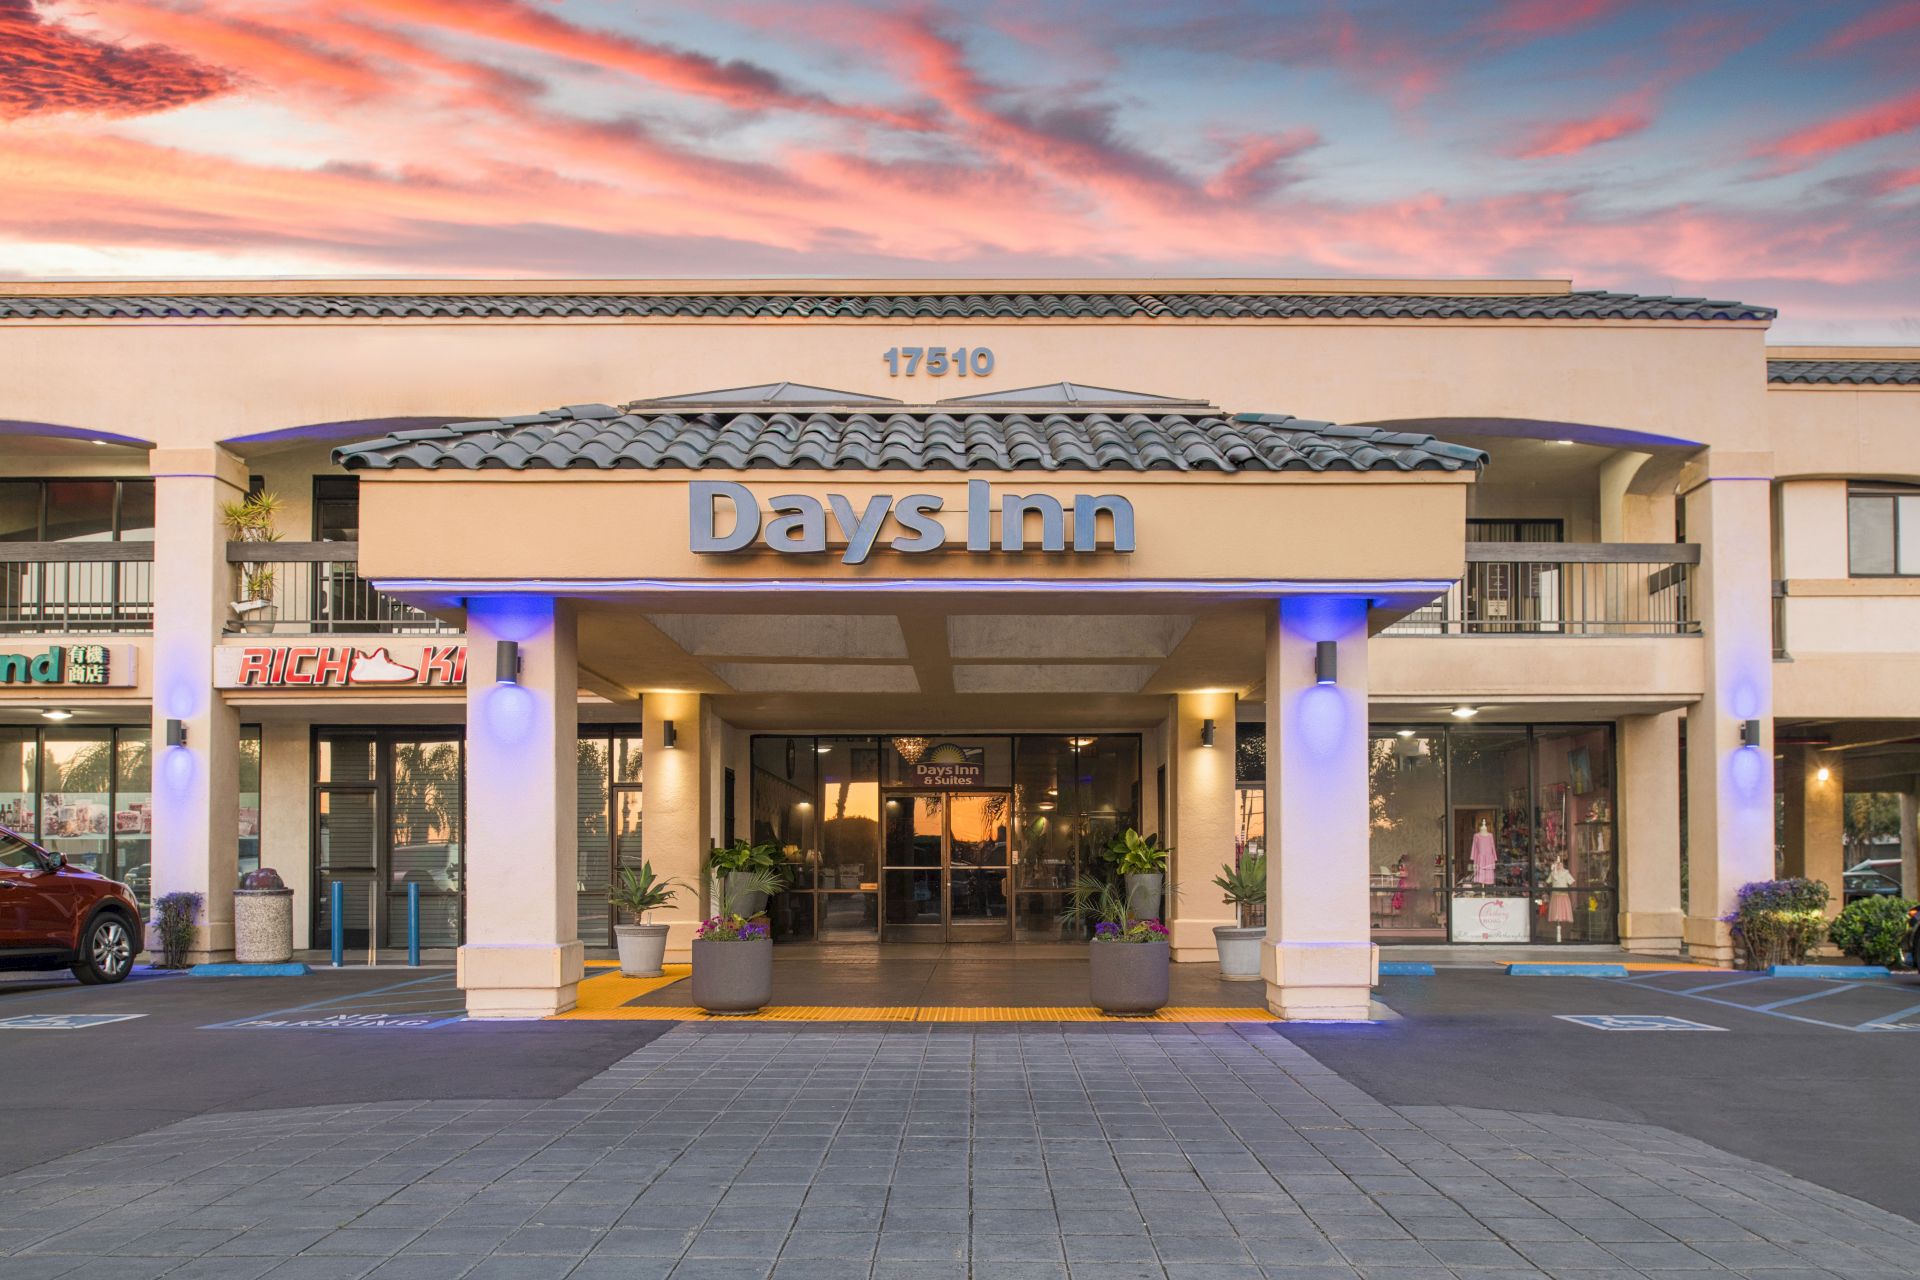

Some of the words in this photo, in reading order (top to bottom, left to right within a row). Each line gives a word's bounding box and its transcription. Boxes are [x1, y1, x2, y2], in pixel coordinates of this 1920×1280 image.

[883, 347, 994, 376] 17510
[689, 479, 946, 565] Days
[967, 479, 1136, 553] Inn
[68, 664, 106, 683] 商店
[236, 647, 352, 685] RICH
[916, 764, 953, 776] Days
[954, 765, 979, 775] Inn
[924, 776, 933, 785] &
[934, 775, 973, 785] Suites
[232, 1019, 430, 1027] PARKING
